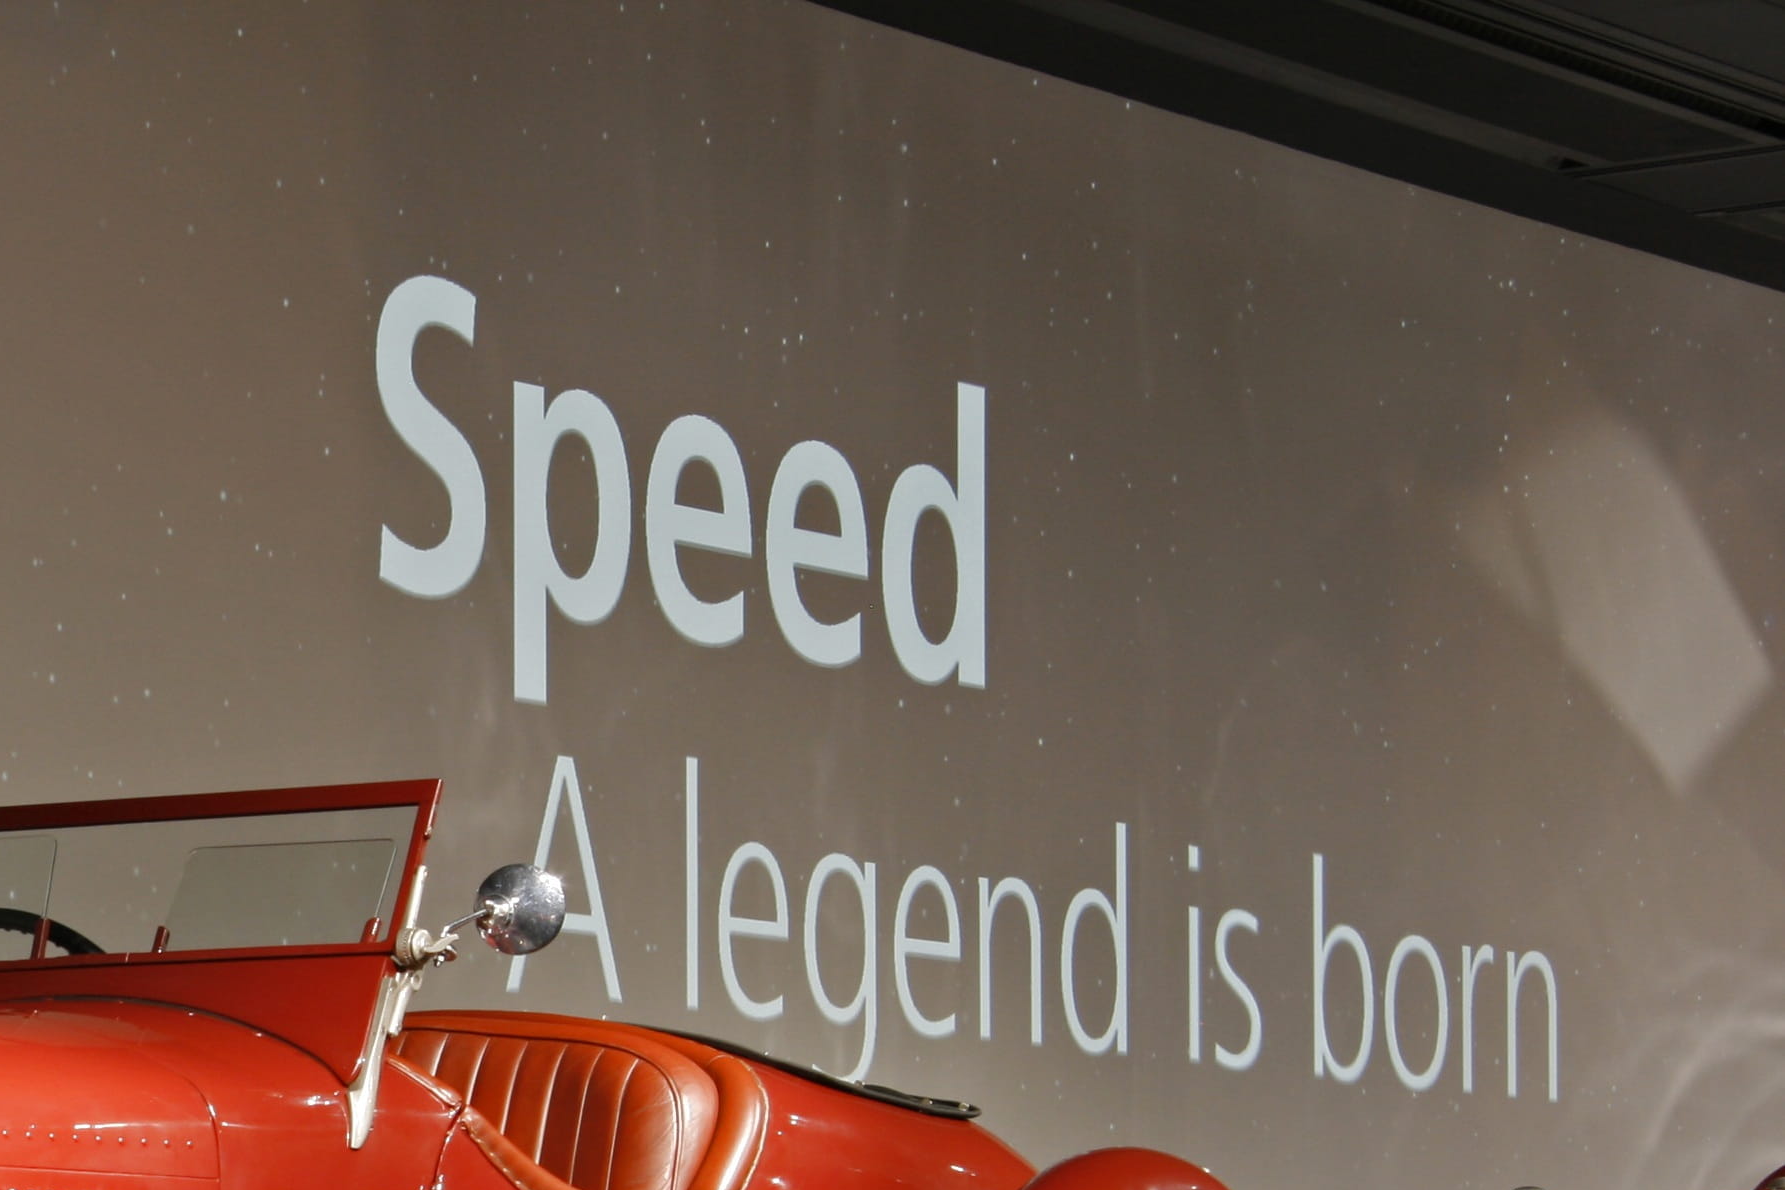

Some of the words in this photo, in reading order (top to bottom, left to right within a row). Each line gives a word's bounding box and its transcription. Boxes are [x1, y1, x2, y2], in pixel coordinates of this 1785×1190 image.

[375, 274, 985, 705] Speed
[506, 755, 622, 1003] A
[685, 756, 1128, 1084] legend
[1187, 844, 1262, 1071] is
[1313, 852, 1558, 1102] born
